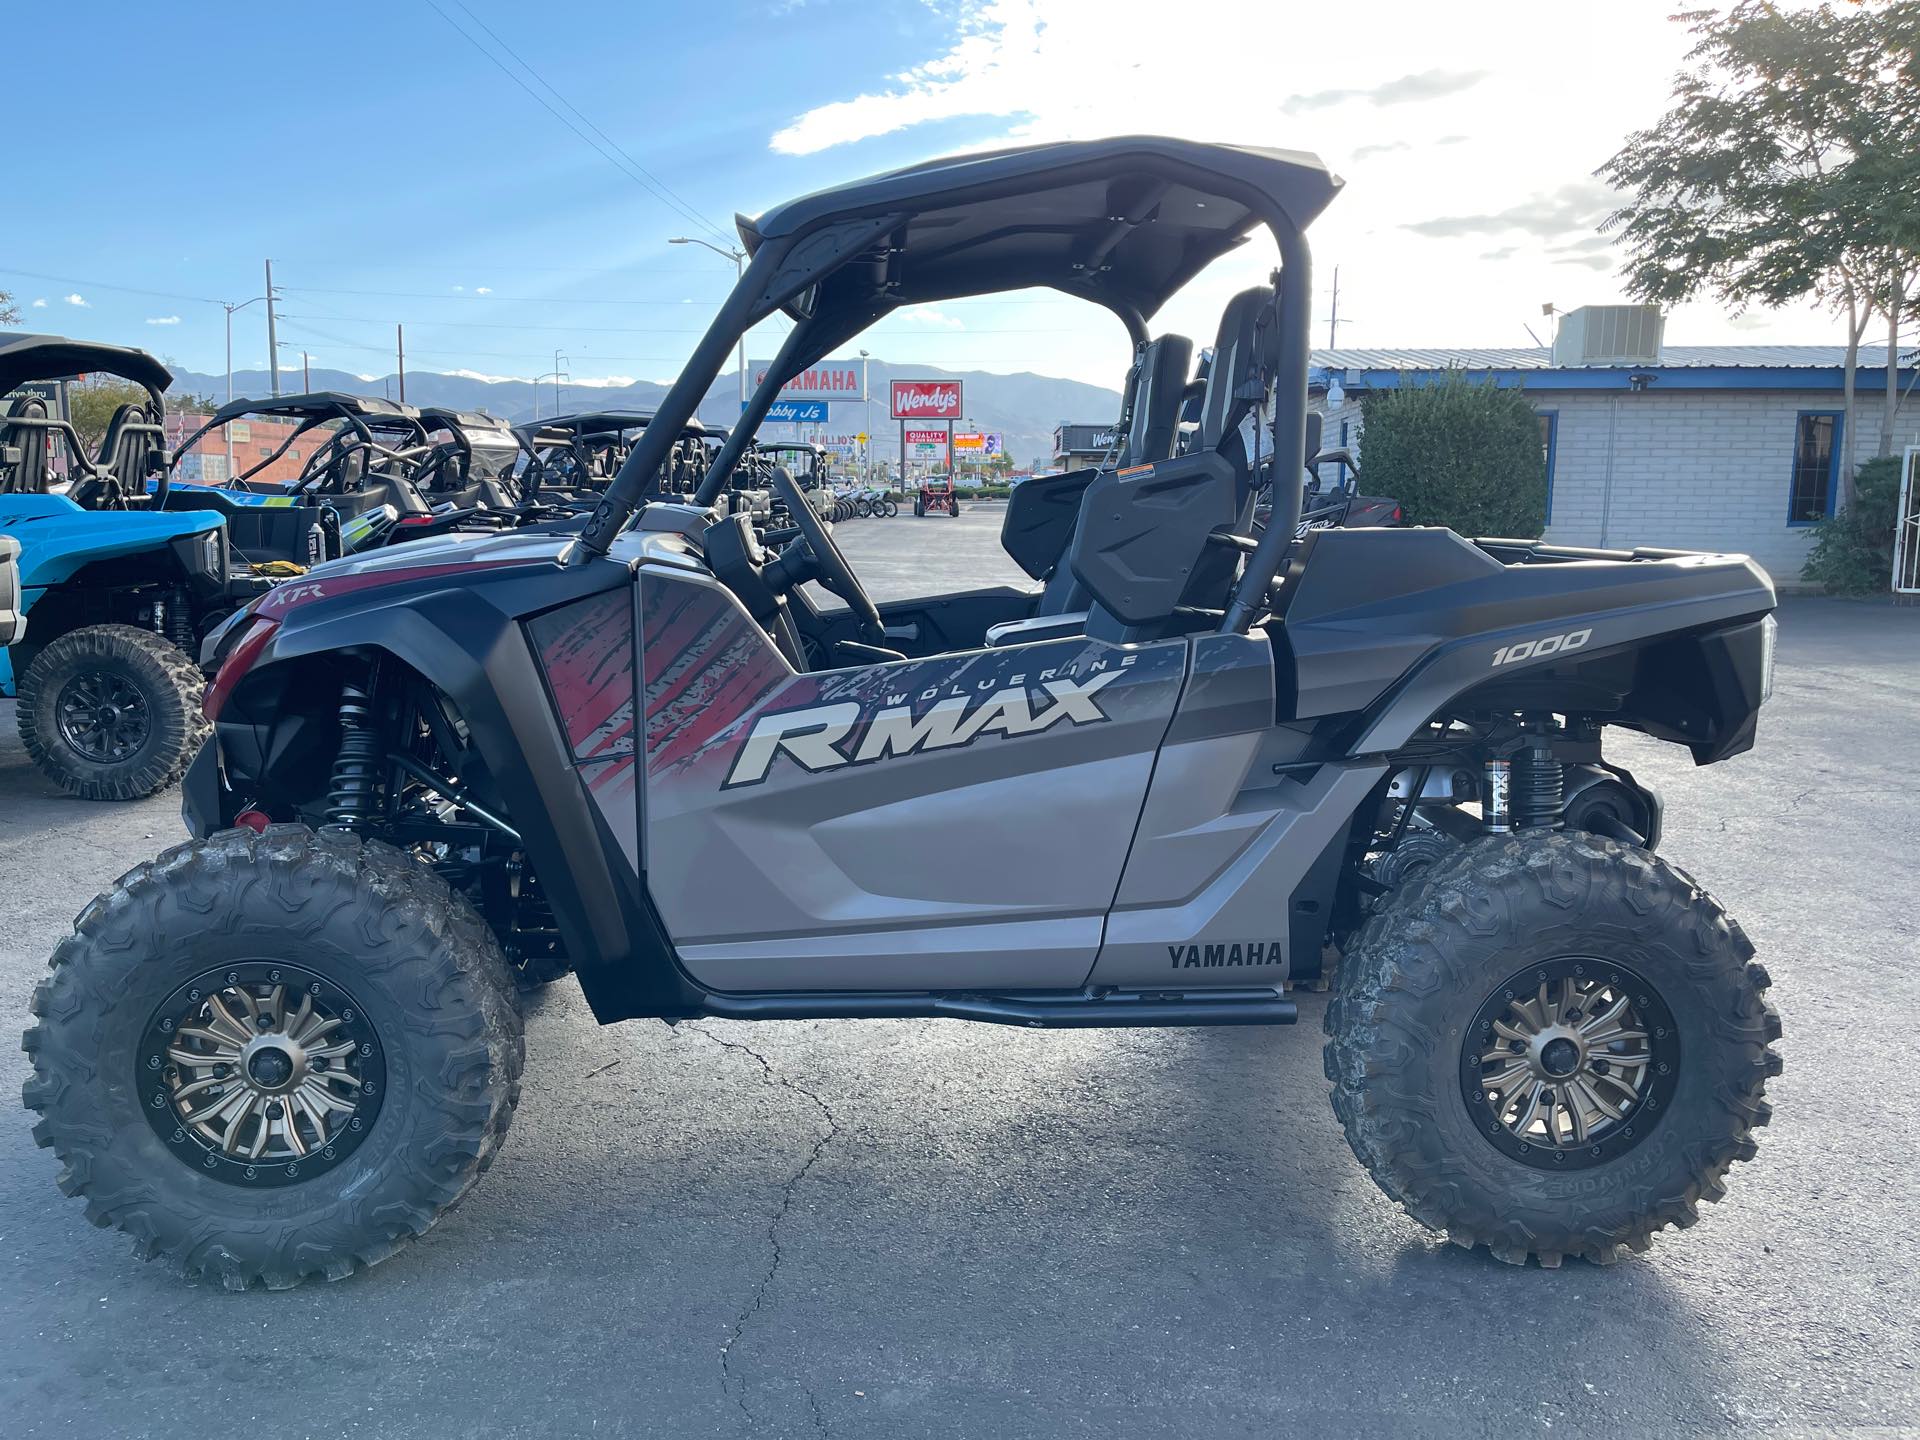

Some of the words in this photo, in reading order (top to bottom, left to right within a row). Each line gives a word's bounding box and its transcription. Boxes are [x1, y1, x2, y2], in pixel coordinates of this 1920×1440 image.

[783, 370, 857, 391] AMAHA
[766, 402, 798, 421] obby
[800, 405, 820, 418] J's
[896, 386, 957, 413] Wendy's
[1491, 628, 1593, 667] 1000
[722, 668, 1128, 789] RMAX
[1167, 942, 1283, 969] YAMAHA
